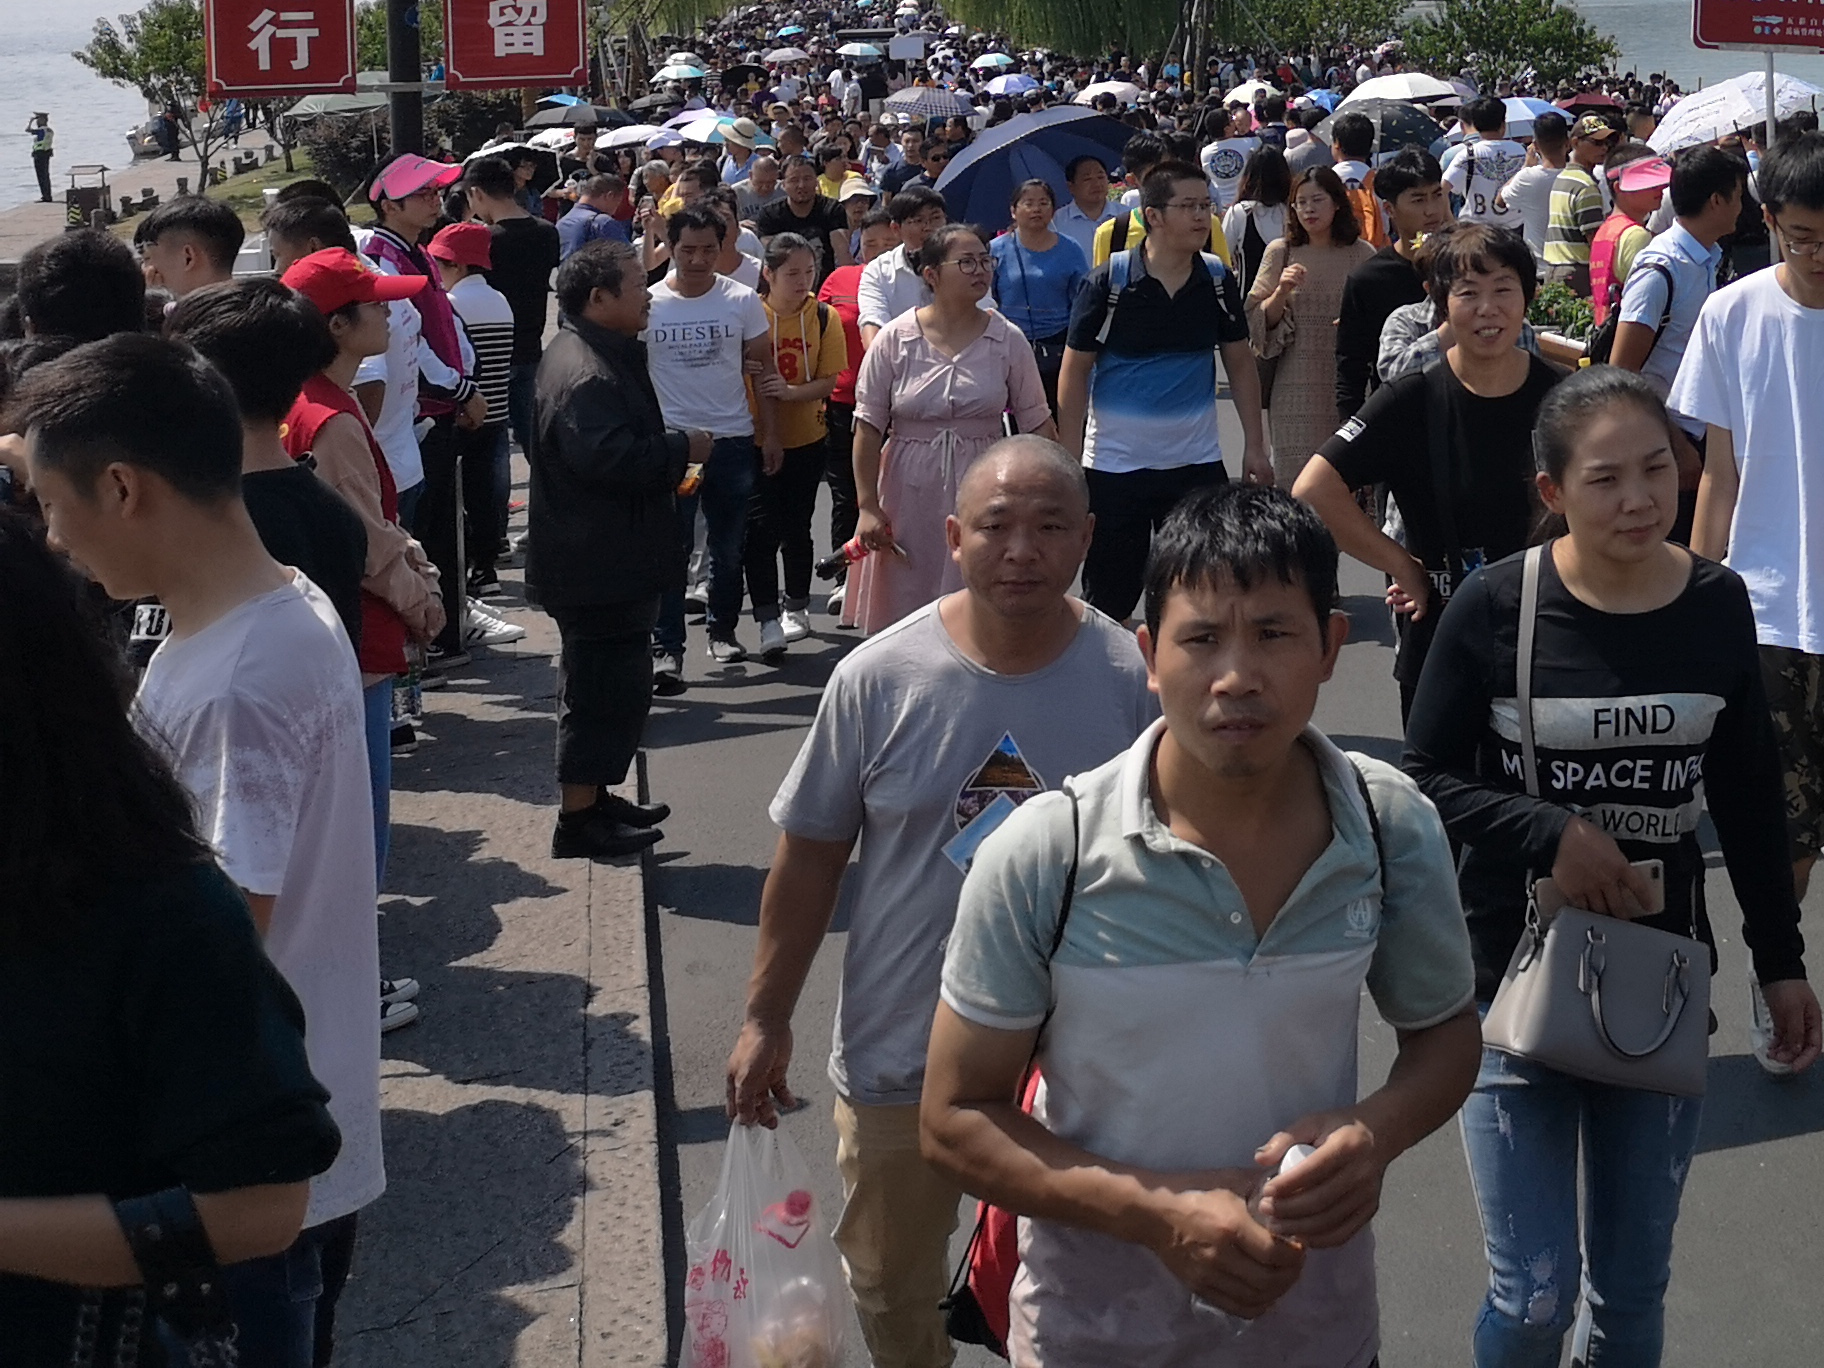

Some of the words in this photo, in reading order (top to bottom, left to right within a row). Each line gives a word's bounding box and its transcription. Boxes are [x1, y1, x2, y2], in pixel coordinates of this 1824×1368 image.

[655, 325, 735, 343] DIESEL
[1593, 704, 1675, 739] FIND
[1550, 759, 1654, 790] SPACE
